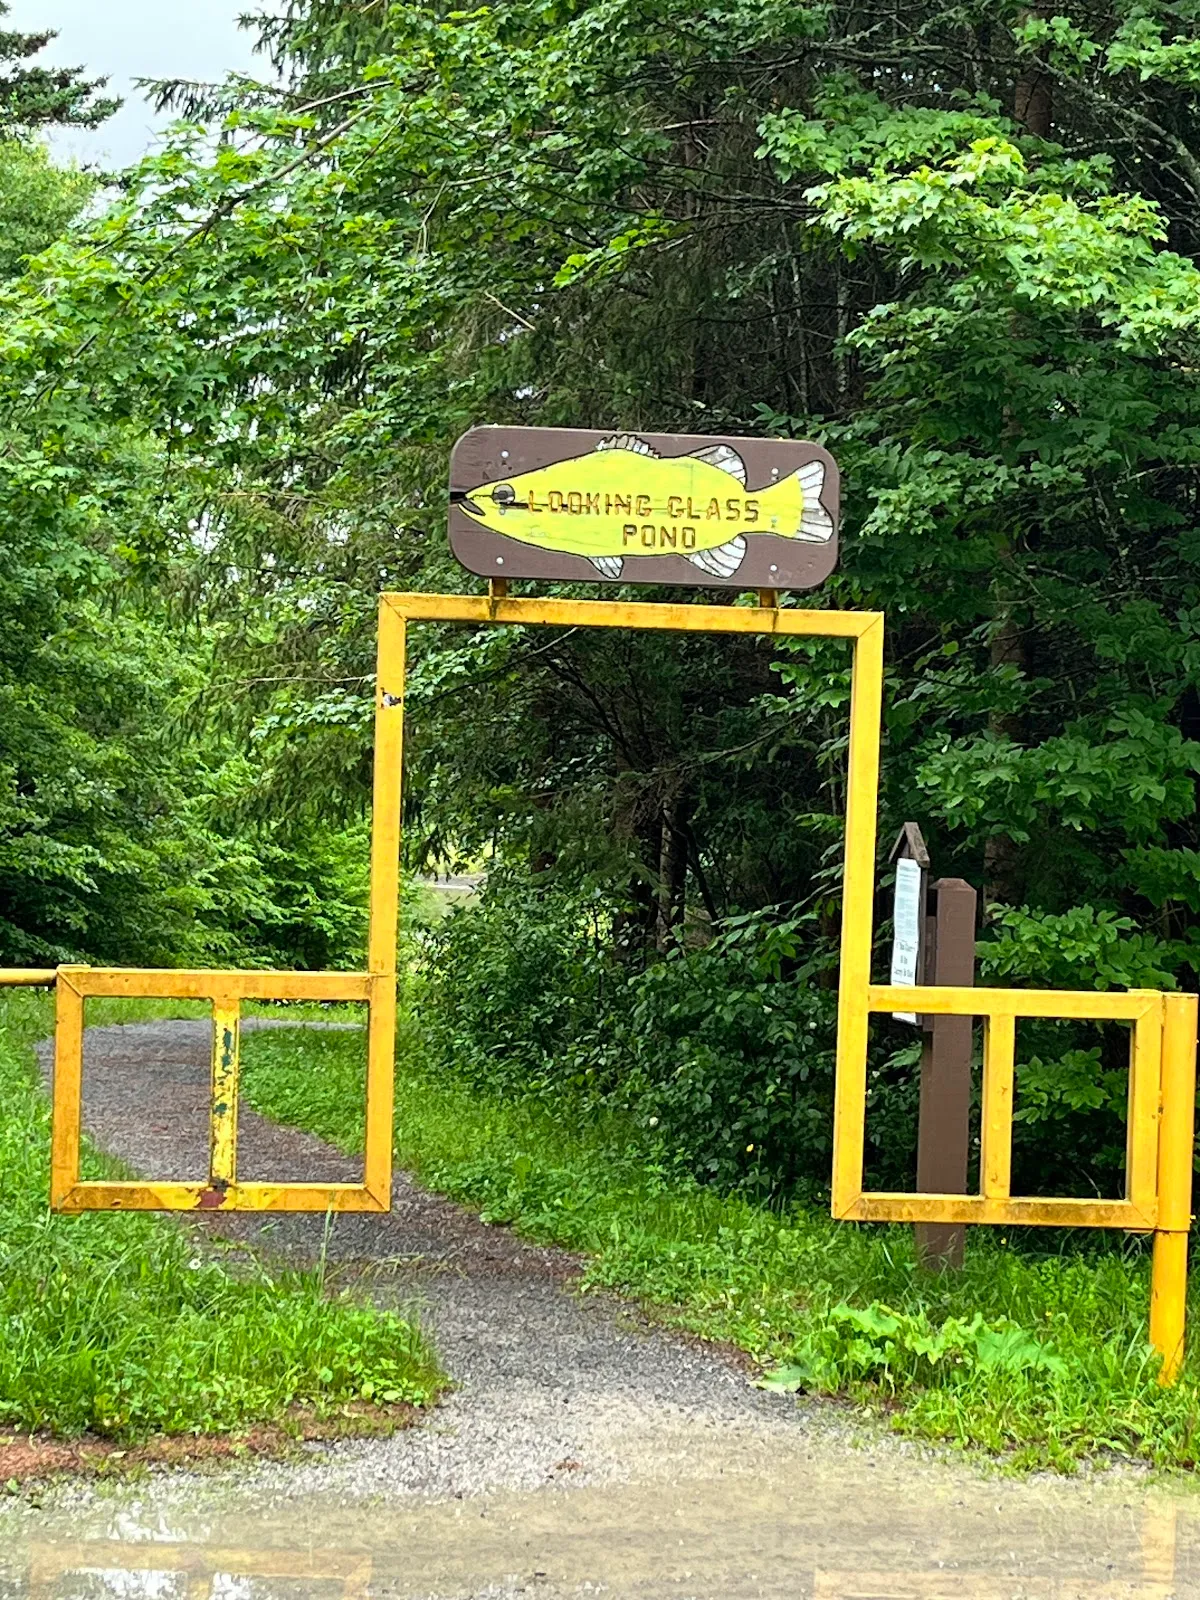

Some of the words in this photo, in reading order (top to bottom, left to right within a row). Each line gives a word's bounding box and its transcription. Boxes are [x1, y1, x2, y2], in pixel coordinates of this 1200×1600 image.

[528, 490, 652, 517] LOOKING
[667, 495, 760, 523] GLASS
[622, 523, 696, 549] POND
